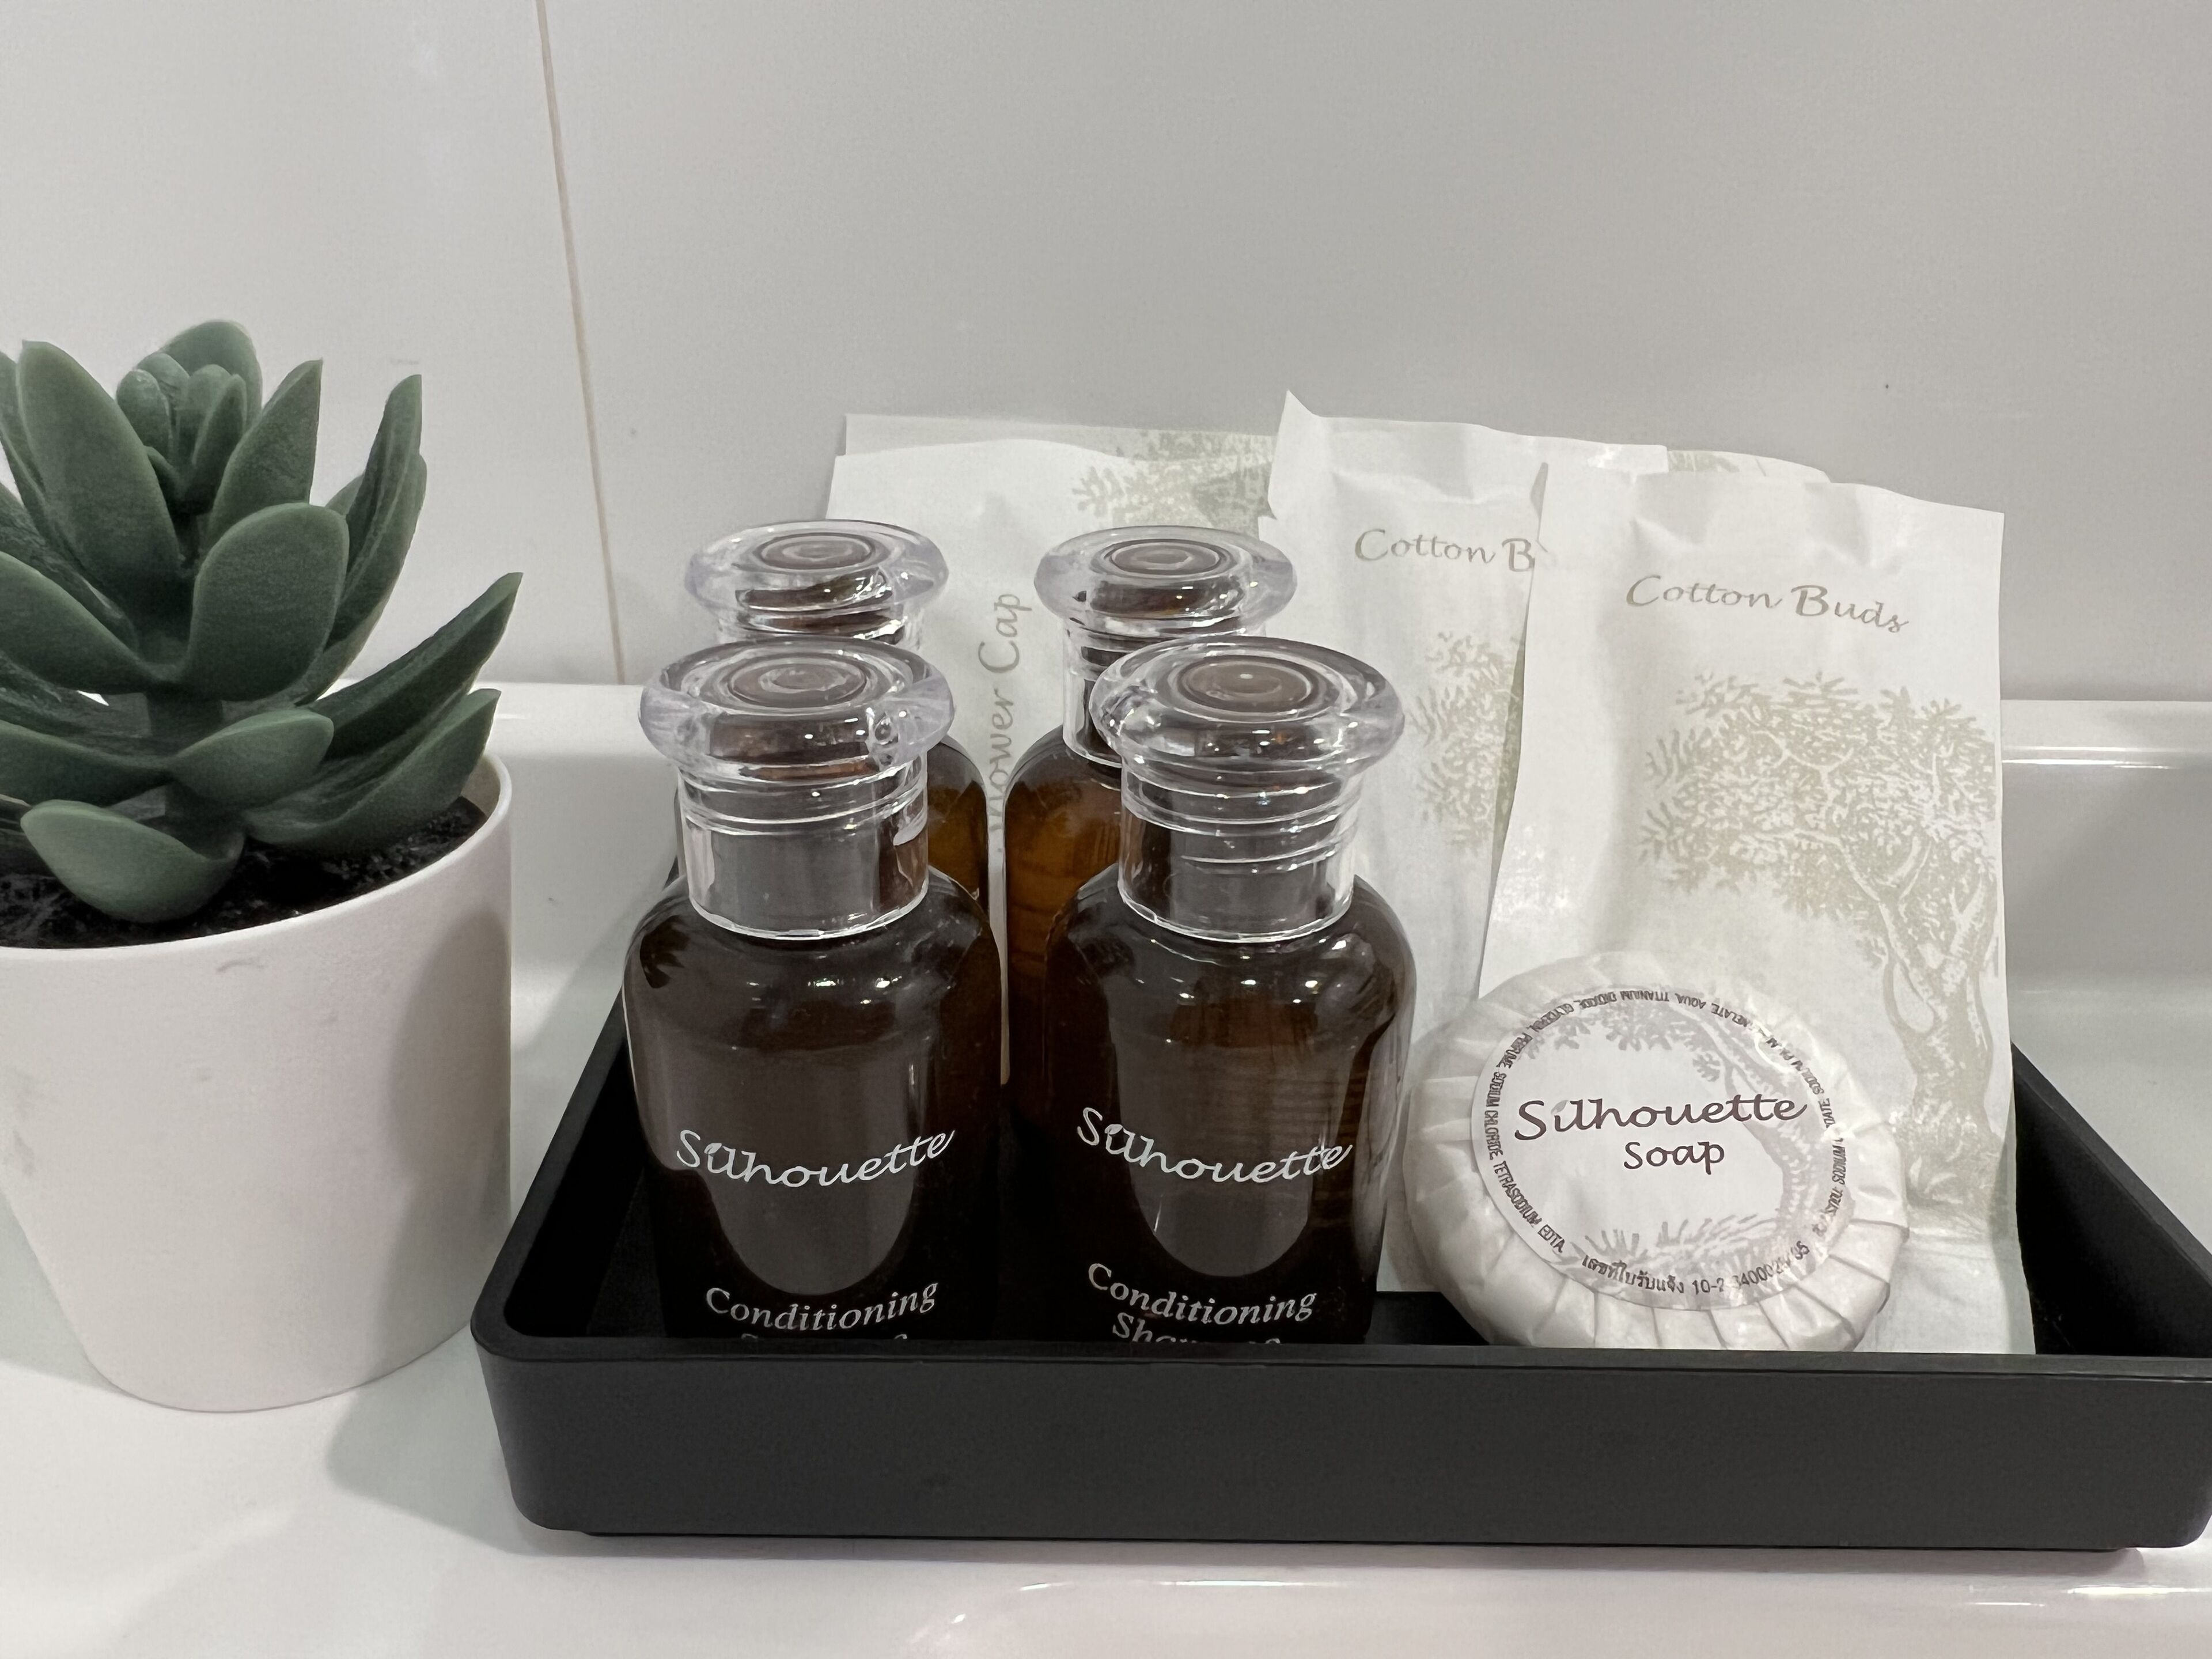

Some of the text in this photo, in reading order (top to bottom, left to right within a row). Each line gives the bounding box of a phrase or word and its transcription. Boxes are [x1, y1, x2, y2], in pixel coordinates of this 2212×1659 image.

[1354, 528, 1496, 564] Cotton
[978, 593, 1033, 674] Cap
[1625, 574, 1910, 635] Cotton Buds
[1077, 1106, 1353, 1183] Silhouette
[1514, 1092, 1808, 1141] Silhouette
[676, 1128, 956, 1188] Silhouette
[1623, 1140, 1726, 1176] Soap
[706, 1282, 938, 1331] Conditioning
[1087, 1263, 1317, 1325] Conditioning
